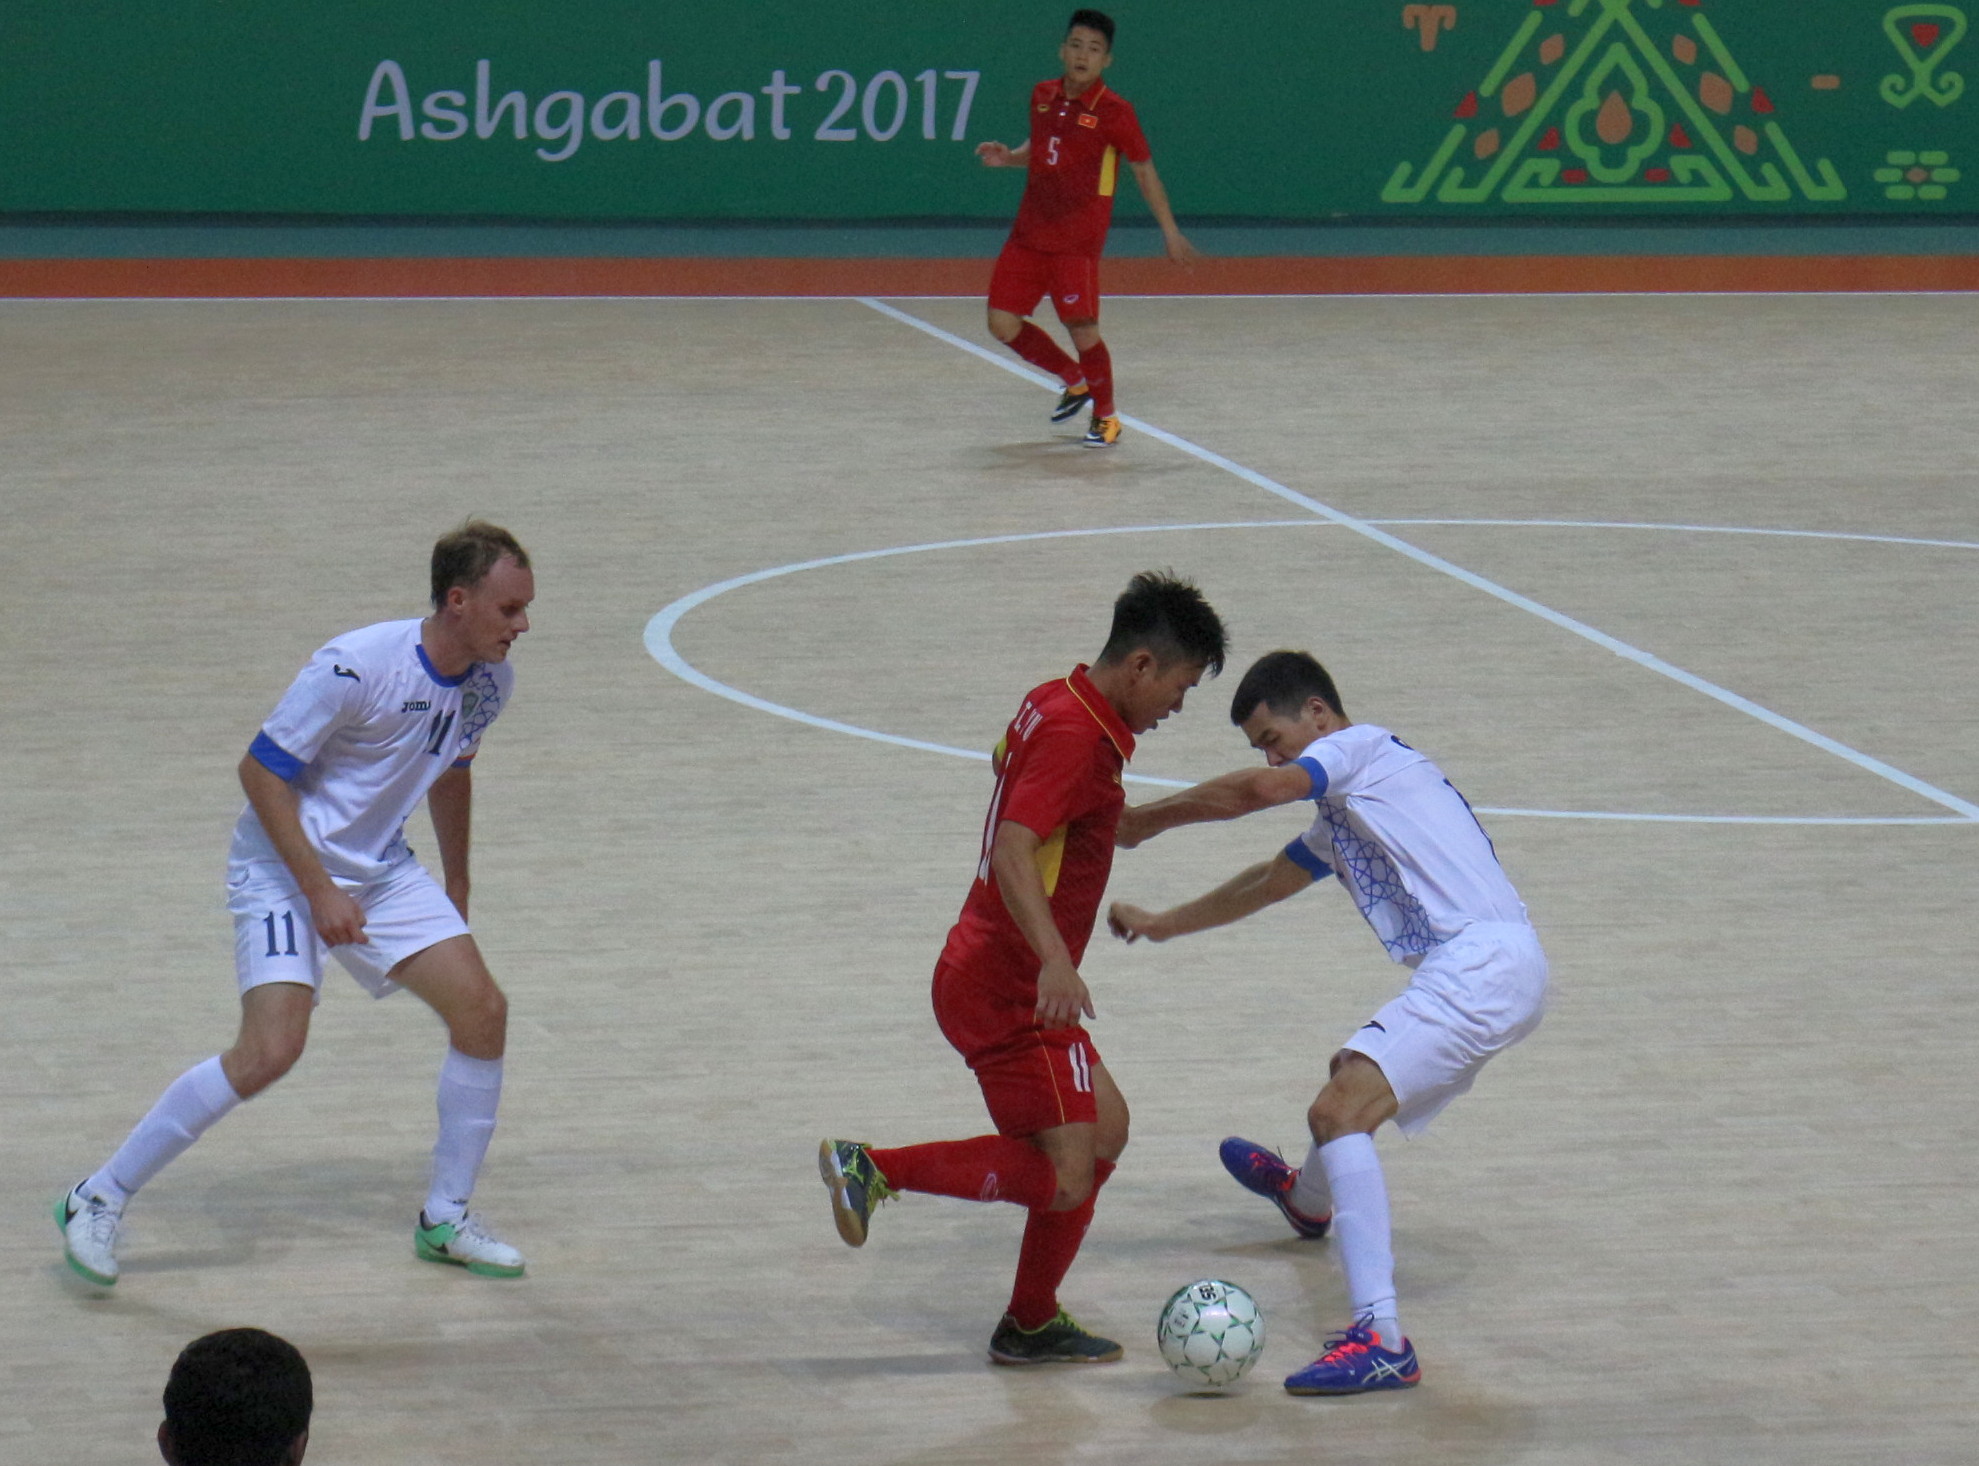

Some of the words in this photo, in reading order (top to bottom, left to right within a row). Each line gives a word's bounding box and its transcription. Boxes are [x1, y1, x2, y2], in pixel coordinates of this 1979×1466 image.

[358, 59, 801, 162] Ashgabat
[815, 69, 981, 142] 2017
[1046, 136, 1061, 166] 5
[263, 910, 299, 957] 11
[1069, 1042, 1091, 1093] 11
